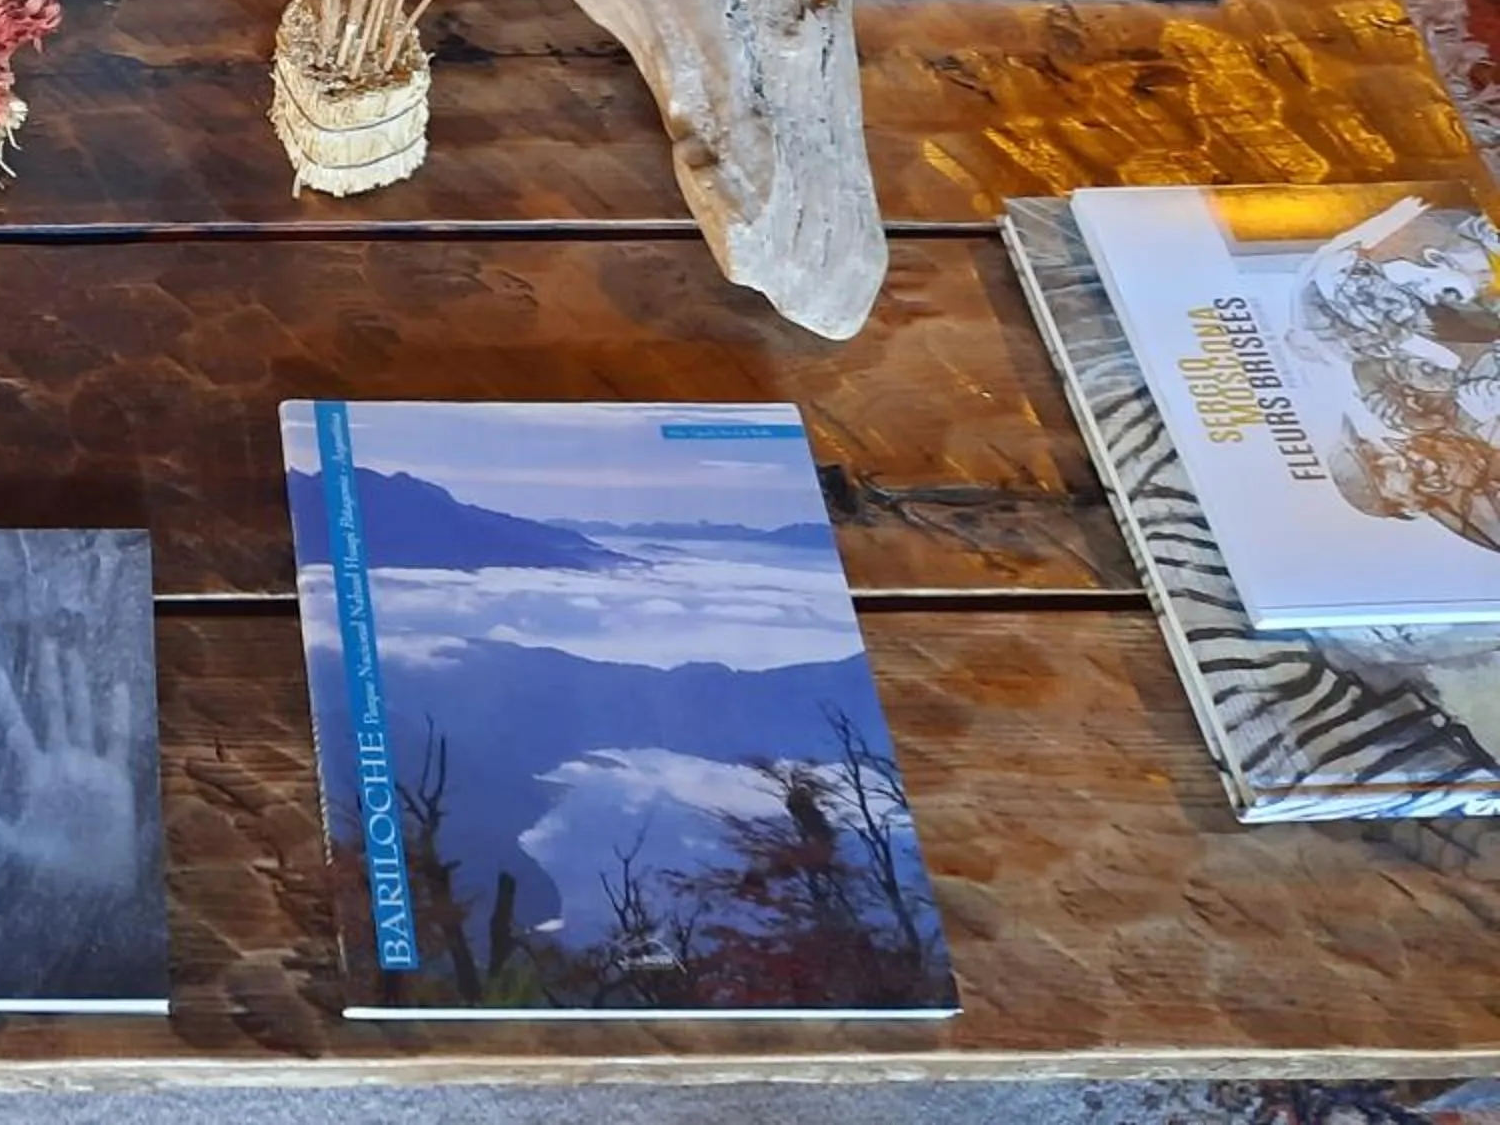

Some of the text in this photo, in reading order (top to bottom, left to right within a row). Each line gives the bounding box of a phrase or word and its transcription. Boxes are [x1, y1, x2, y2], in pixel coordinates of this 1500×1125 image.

[1178, 357, 1245, 443] SERGIO
[1187, 307, 1267, 426] MOSCONA
[1257, 396, 1328, 481] FLEURS
[357, 732, 411, 966] BARILOCHE
